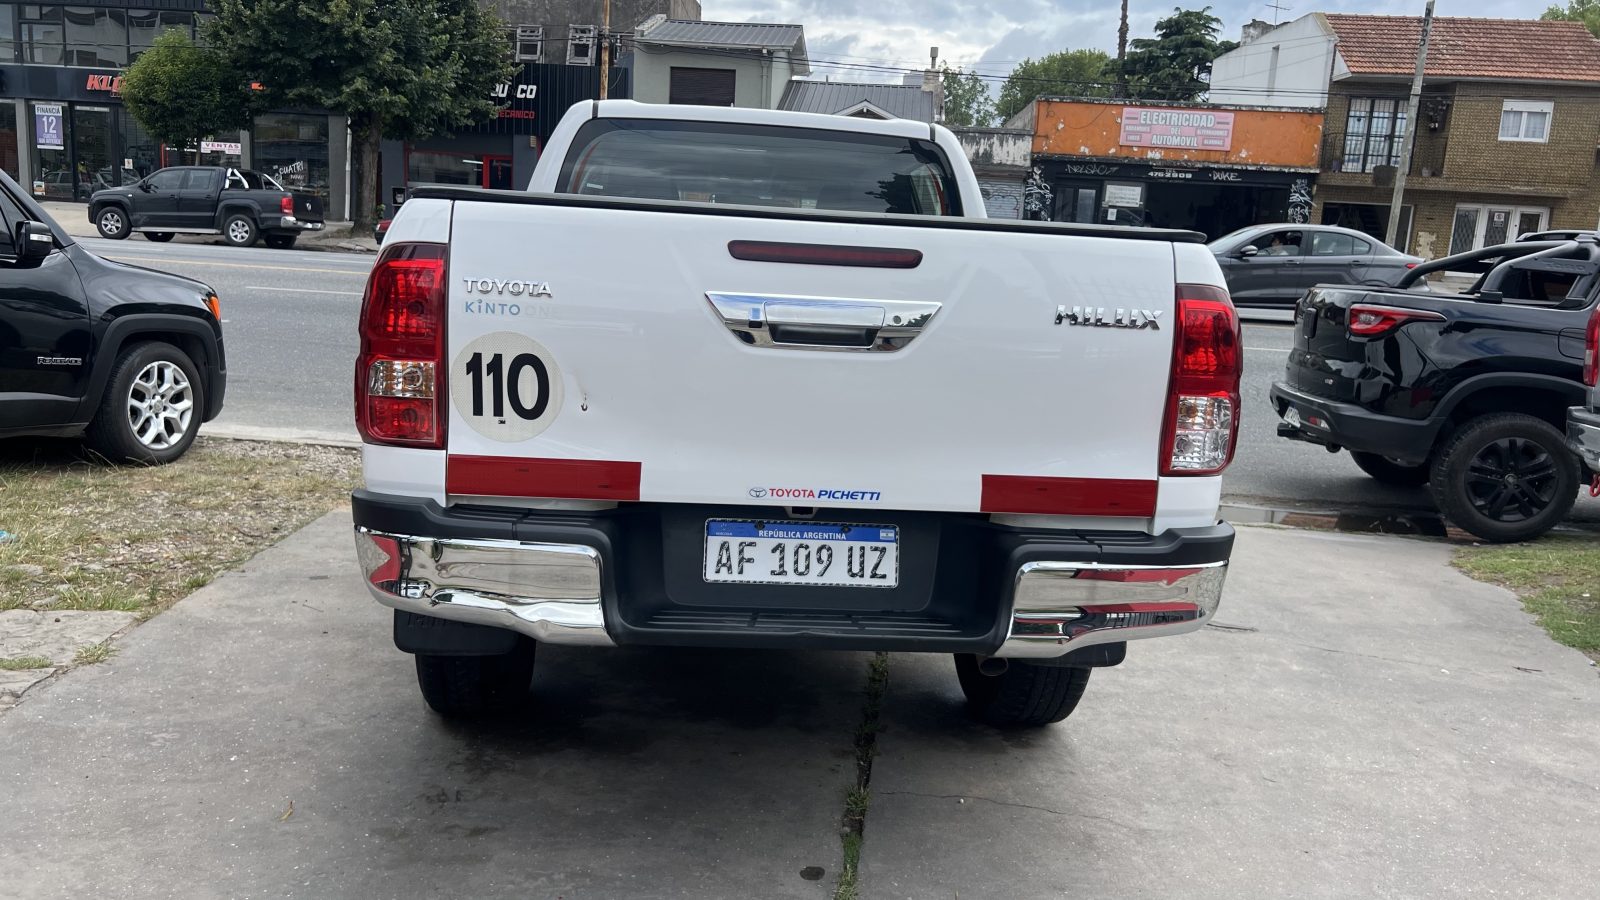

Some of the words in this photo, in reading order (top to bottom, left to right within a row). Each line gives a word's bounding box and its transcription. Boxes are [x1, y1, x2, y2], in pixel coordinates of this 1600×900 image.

[42, 115, 57, 134] 12
[1140, 111, 1215, 128] ELECTRICIDAD
[1151, 134, 1198, 147] AUTOMOVIL
[463, 276, 553, 298] TOYOTA
[1055, 304, 1164, 330] HILUX
[466, 352, 550, 420] 110
[769, 488, 815, 499] TOYOTA
[817, 489, 881, 501] PICHETTI
[758, 529, 800, 538] REPÚBLICA
[803, 532, 847, 540] ARGENTINA
[715, 541, 757, 574] AF
[770, 543, 833, 577] 109
[847, 545, 887, 579] UZ
